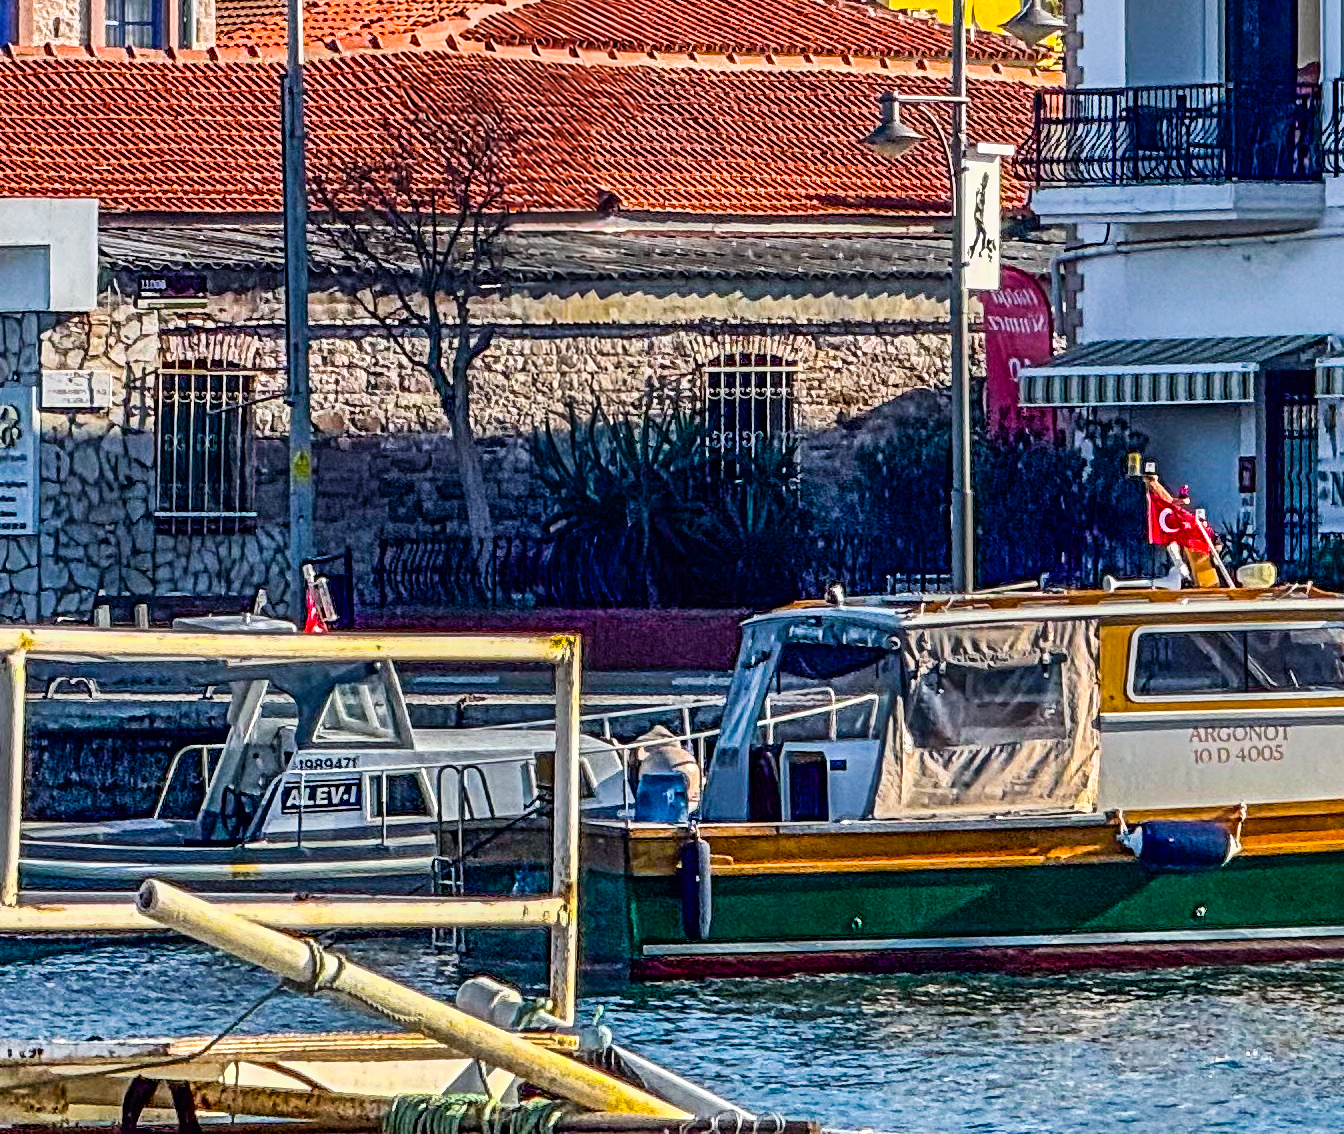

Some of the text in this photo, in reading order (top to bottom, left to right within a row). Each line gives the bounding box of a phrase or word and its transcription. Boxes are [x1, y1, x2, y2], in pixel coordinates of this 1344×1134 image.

[1189, 725, 1289, 743] ARGONOT
[1193, 745, 1285, 764] 10 D 4005
